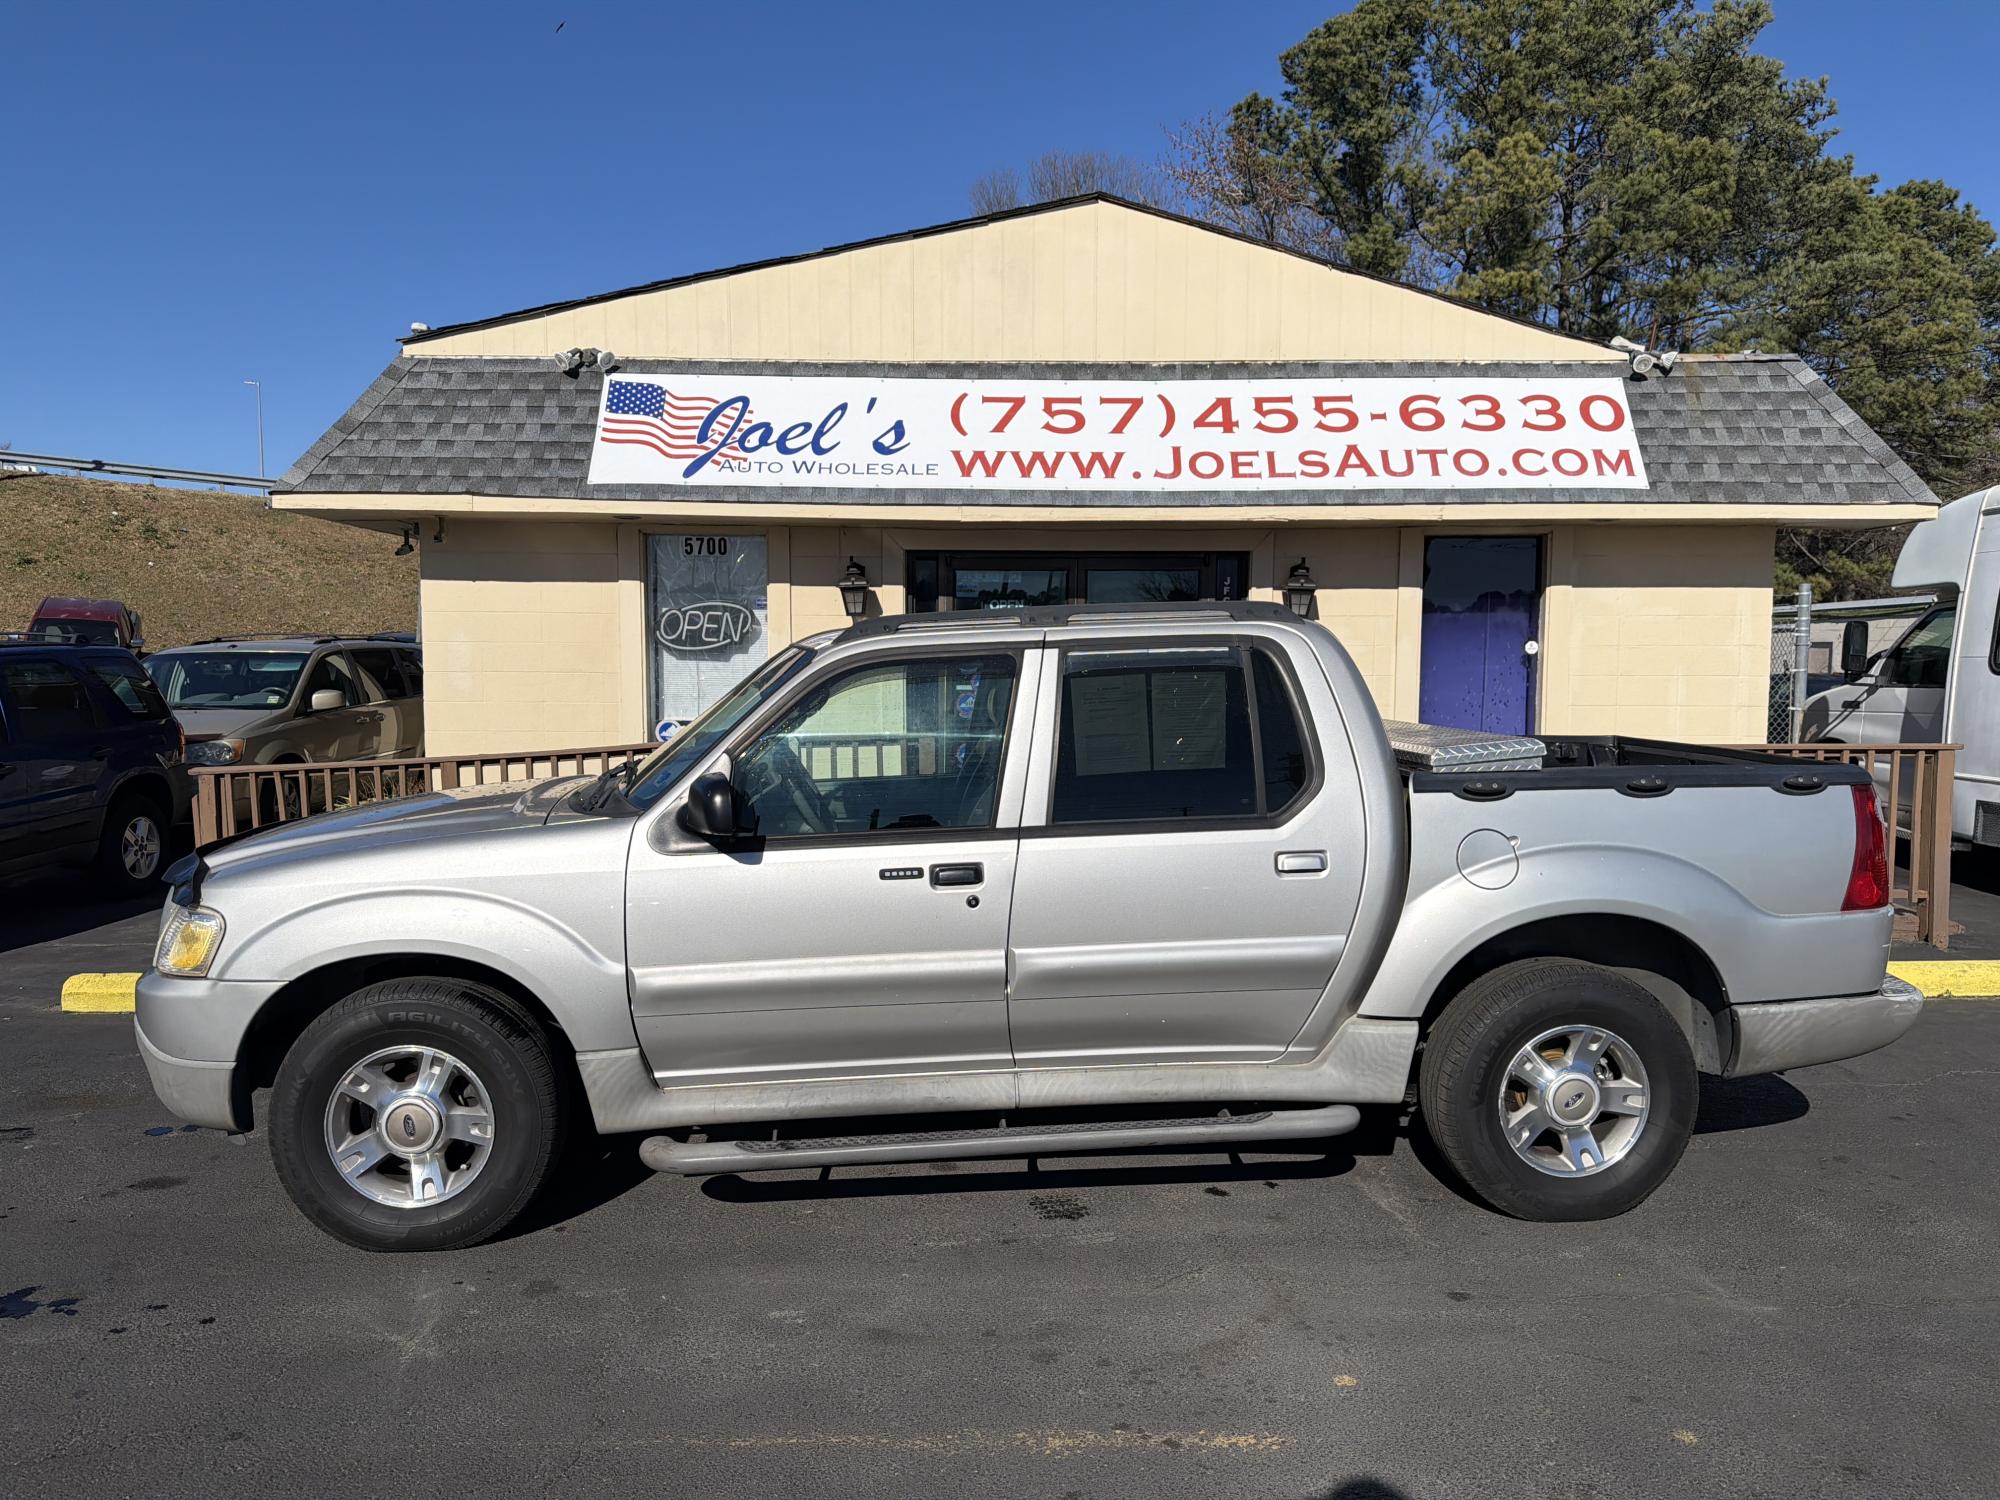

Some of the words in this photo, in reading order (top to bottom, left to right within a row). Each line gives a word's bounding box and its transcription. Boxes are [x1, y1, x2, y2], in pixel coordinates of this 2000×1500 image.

[683, 395, 911, 479] Joel's
[792, 460, 938, 476] WHOLESALE
[951, 444, 1638, 480] WWW.JOELSAUTO.COM
[684, 537, 728, 556] 5700
[660, 609, 744, 642] OPEN
